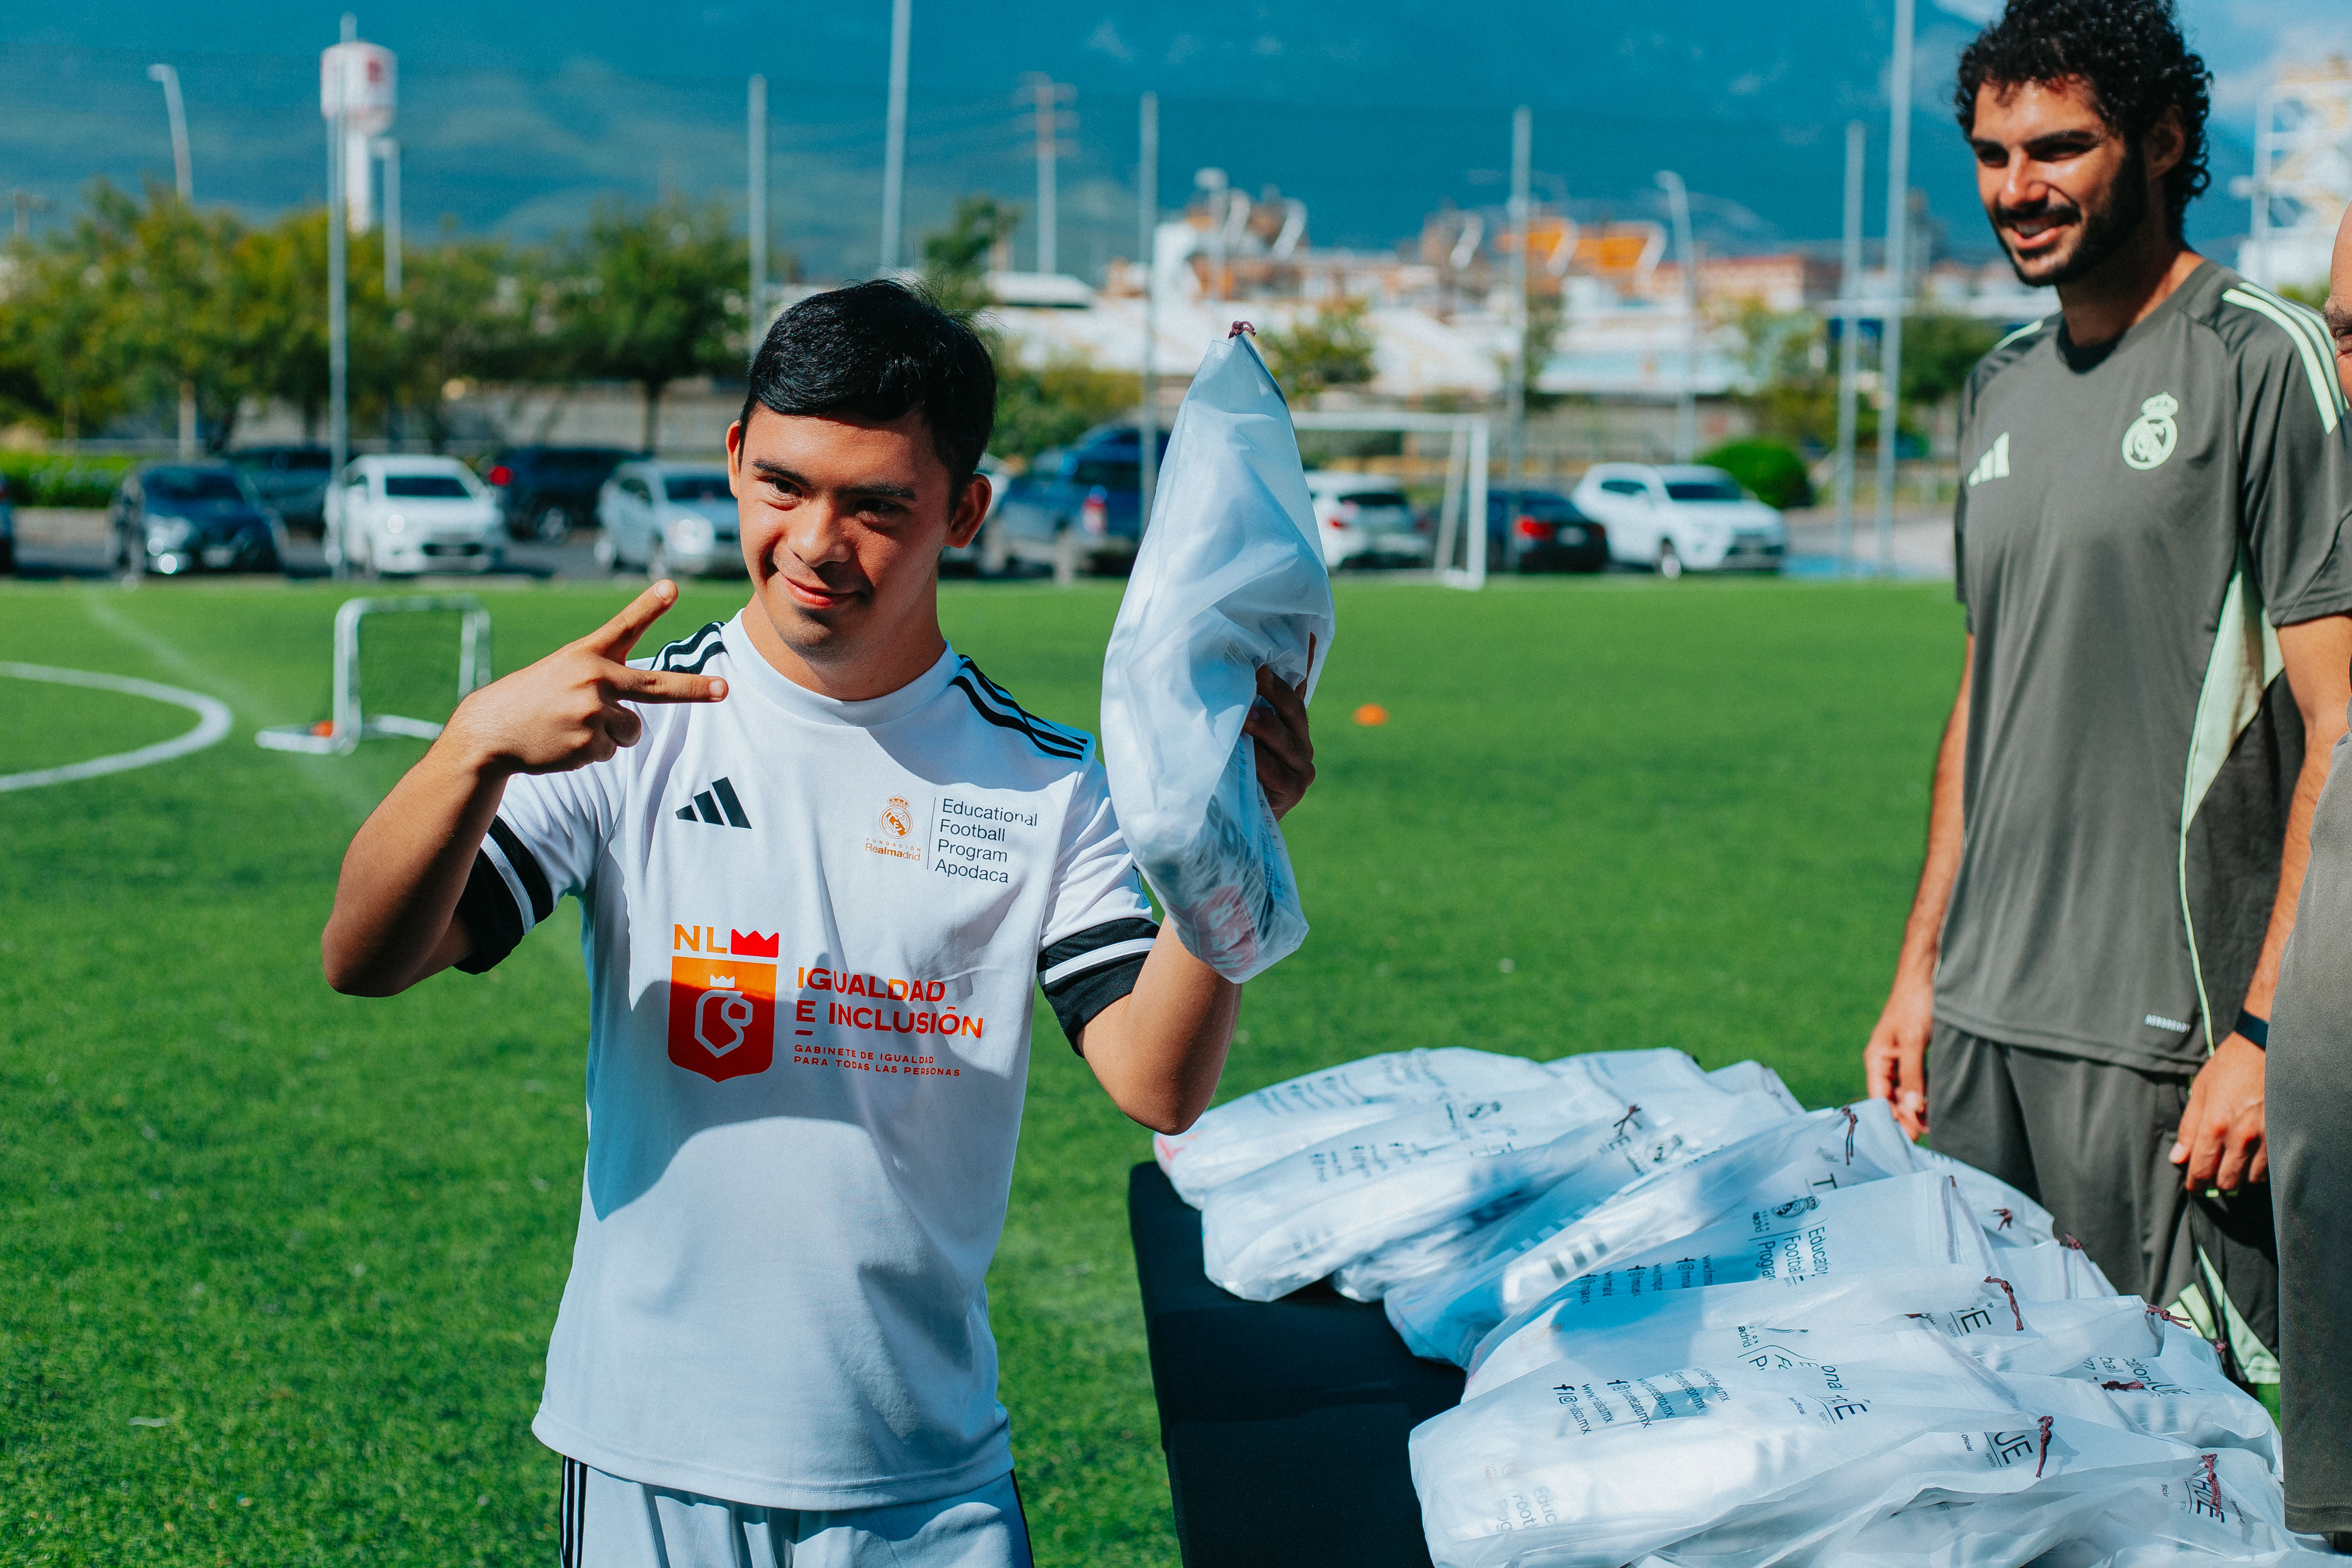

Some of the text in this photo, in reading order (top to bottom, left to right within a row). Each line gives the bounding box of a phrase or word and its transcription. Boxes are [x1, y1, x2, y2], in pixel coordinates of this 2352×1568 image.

[942, 798, 1038, 826] Educational
[940, 819, 1005, 842] Football
[865, 843, 920, 861] Realmadrid
[866, 838, 921, 851] FUNDACIÓN
[938, 839, 1008, 862] Program
[935, 859, 1008, 884] Apodaca
[674, 924, 727, 954] NL
[798, 967, 945, 1002] IGUALDAD
[796, 999, 983, 1039] E INCLUSIÓN
[794, 1044, 934, 1064] GABINETE DE IGUALDAD
[794, 1056, 960, 1077] PARA TODAS LAS PERSONAS
[1783, 1235, 1806, 1276] Football
[1821, 1364, 1850, 1390] onal
[1818, 1411, 1831, 1427] sports
[1961, 1434, 1974, 1452] Oficial
[1986, 1453, 1996, 1468] sports
